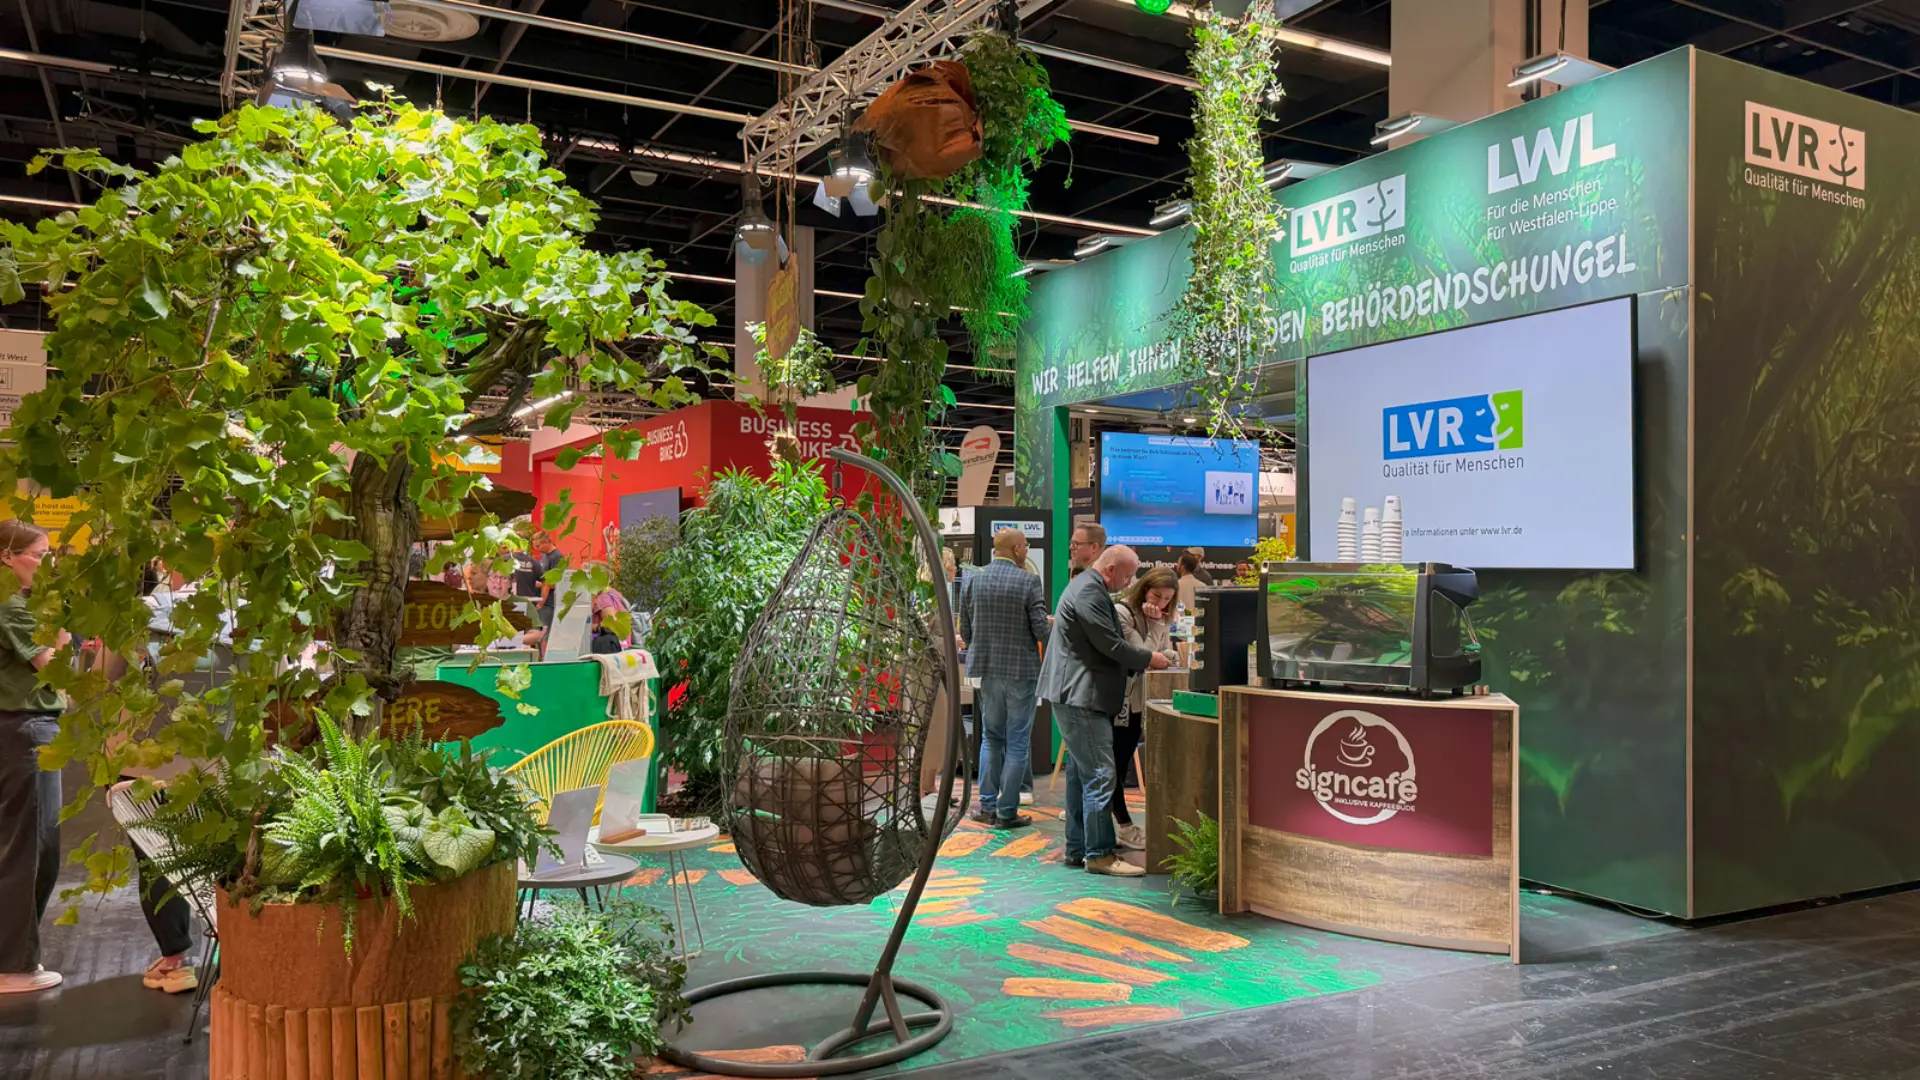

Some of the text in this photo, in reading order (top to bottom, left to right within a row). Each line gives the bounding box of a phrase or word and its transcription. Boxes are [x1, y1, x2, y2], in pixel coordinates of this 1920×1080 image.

[1488, 112, 1616, 194] LWL
[1752, 111, 1820, 171] LVR
[1486, 179, 1604, 221] Für die Menschen.
[1744, 168, 1866, 209] Qualität für Menschen
[1296, 199, 1358, 249] LVR
[1486, 198, 1620, 241] Für Westfalen-Lippe.
[1289, 233, 1406, 274] Qualität für Menschen
[1031, 366, 1059, 396] WIR
[1066, 352, 1120, 389] HELFEN
[1127, 338, 1182, 378] IHNEN
[1264, 306, 1306, 346] DEN
[1320, 233, 1637, 336] BEHÖRDENDSCHUNGEL
[7, 352, 29, 361] West
[646, 425, 674, 447] BUSINESS
[802, 440, 832, 459] IKE
[1389, 406, 1466, 452] LVR
[659, 444, 674, 462] BIKE
[1382, 454, 1524, 478] Qualität für Menschen
[1410, 527, 1458, 537] Informationen
[1459, 527, 1480, 536] unter
[1480, 525, 1523, 536] www.lvr.de
[1334, 797, 1369, 808] INKLUSIVE
